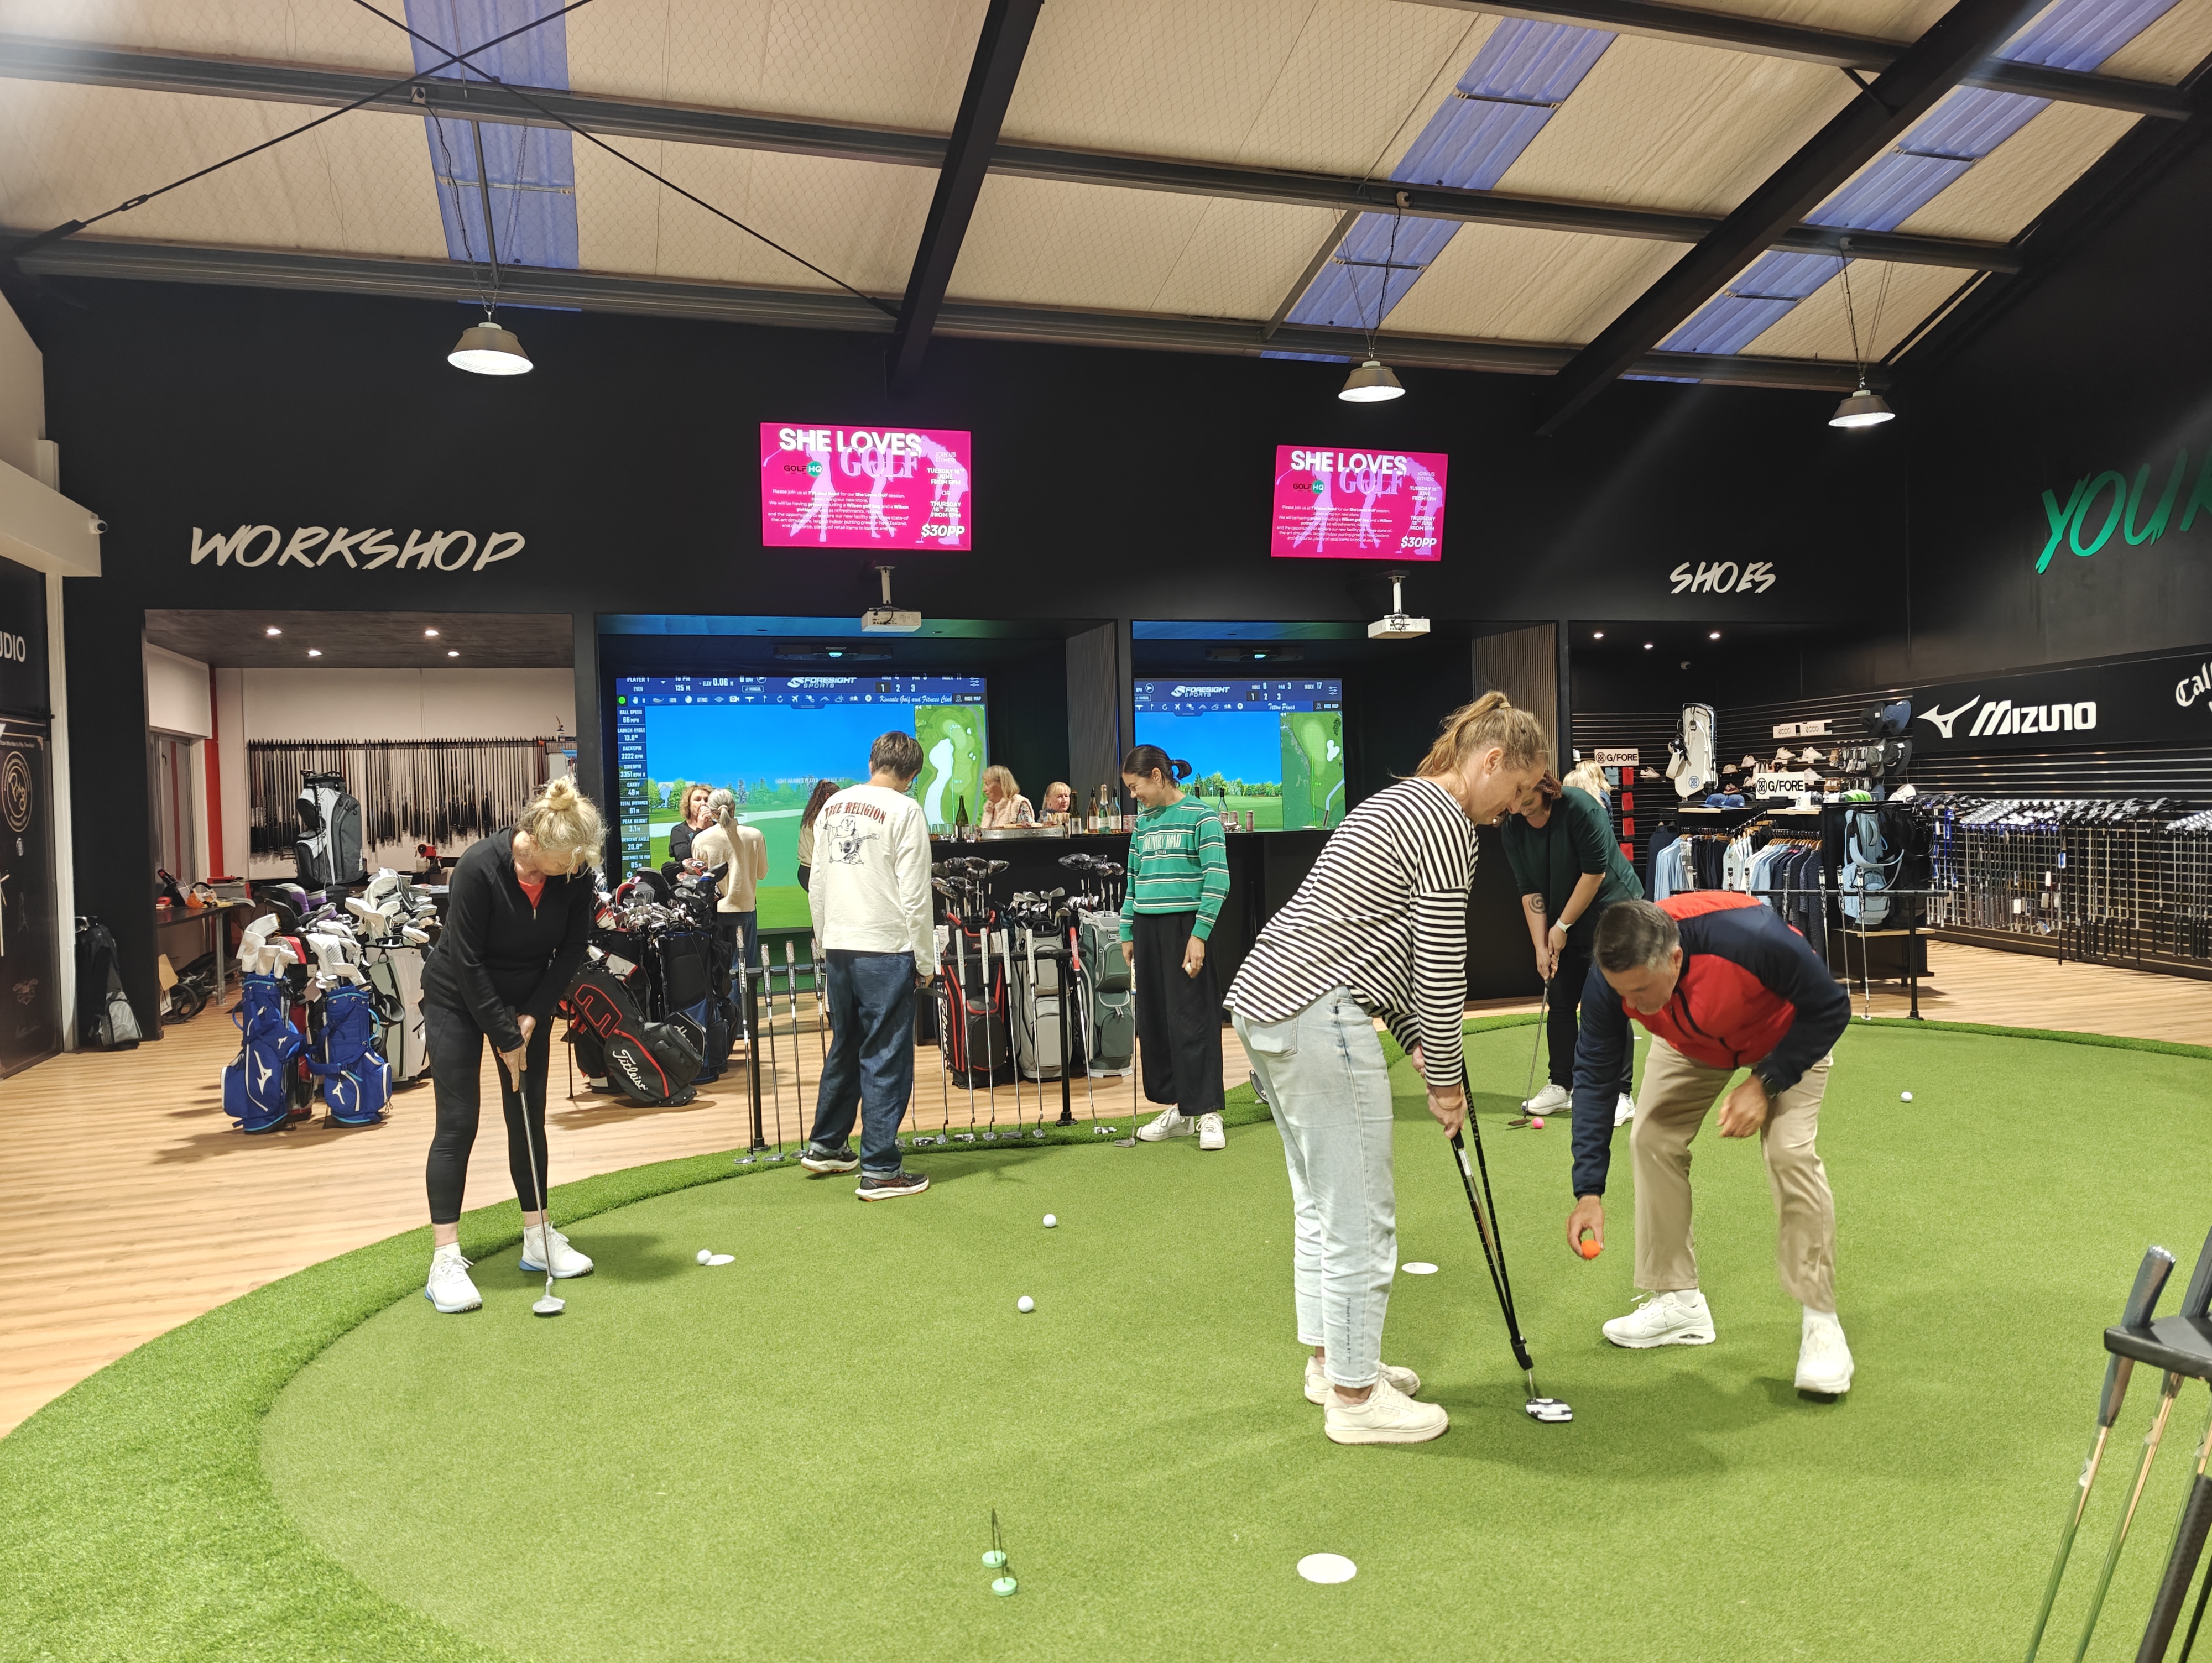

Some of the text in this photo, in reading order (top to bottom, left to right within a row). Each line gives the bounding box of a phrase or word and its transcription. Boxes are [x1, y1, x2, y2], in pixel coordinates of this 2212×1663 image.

[779, 428, 922, 457] SHE LOVES
[840, 446, 919, 478] GOLF
[1291, 450, 1407, 476] SHE LOVES
[1339, 467, 1402, 495] GOLF
[921, 523, 965, 538] $30PP
[1401, 535, 1437, 548] $30PP
[190, 524, 526, 572] WORKSHOP
[1669, 561, 1776, 594] SHOES
[713, 678, 728, 686] 0.06
[881, 684, 915, 692] 1 2 3
[2176, 661, 2212, 707] Cal
[900, 695, 910, 704] Golf
[921, 695, 940, 704] Fitness
[1606, 753, 1638, 762] G/FORE
[1768, 779, 1804, 793] G/FORE
[825, 802, 887, 825] TRUE RELIGION
[1166, 834, 1181, 848] ROAD
[612, 1049, 647, 1090] Titleist
